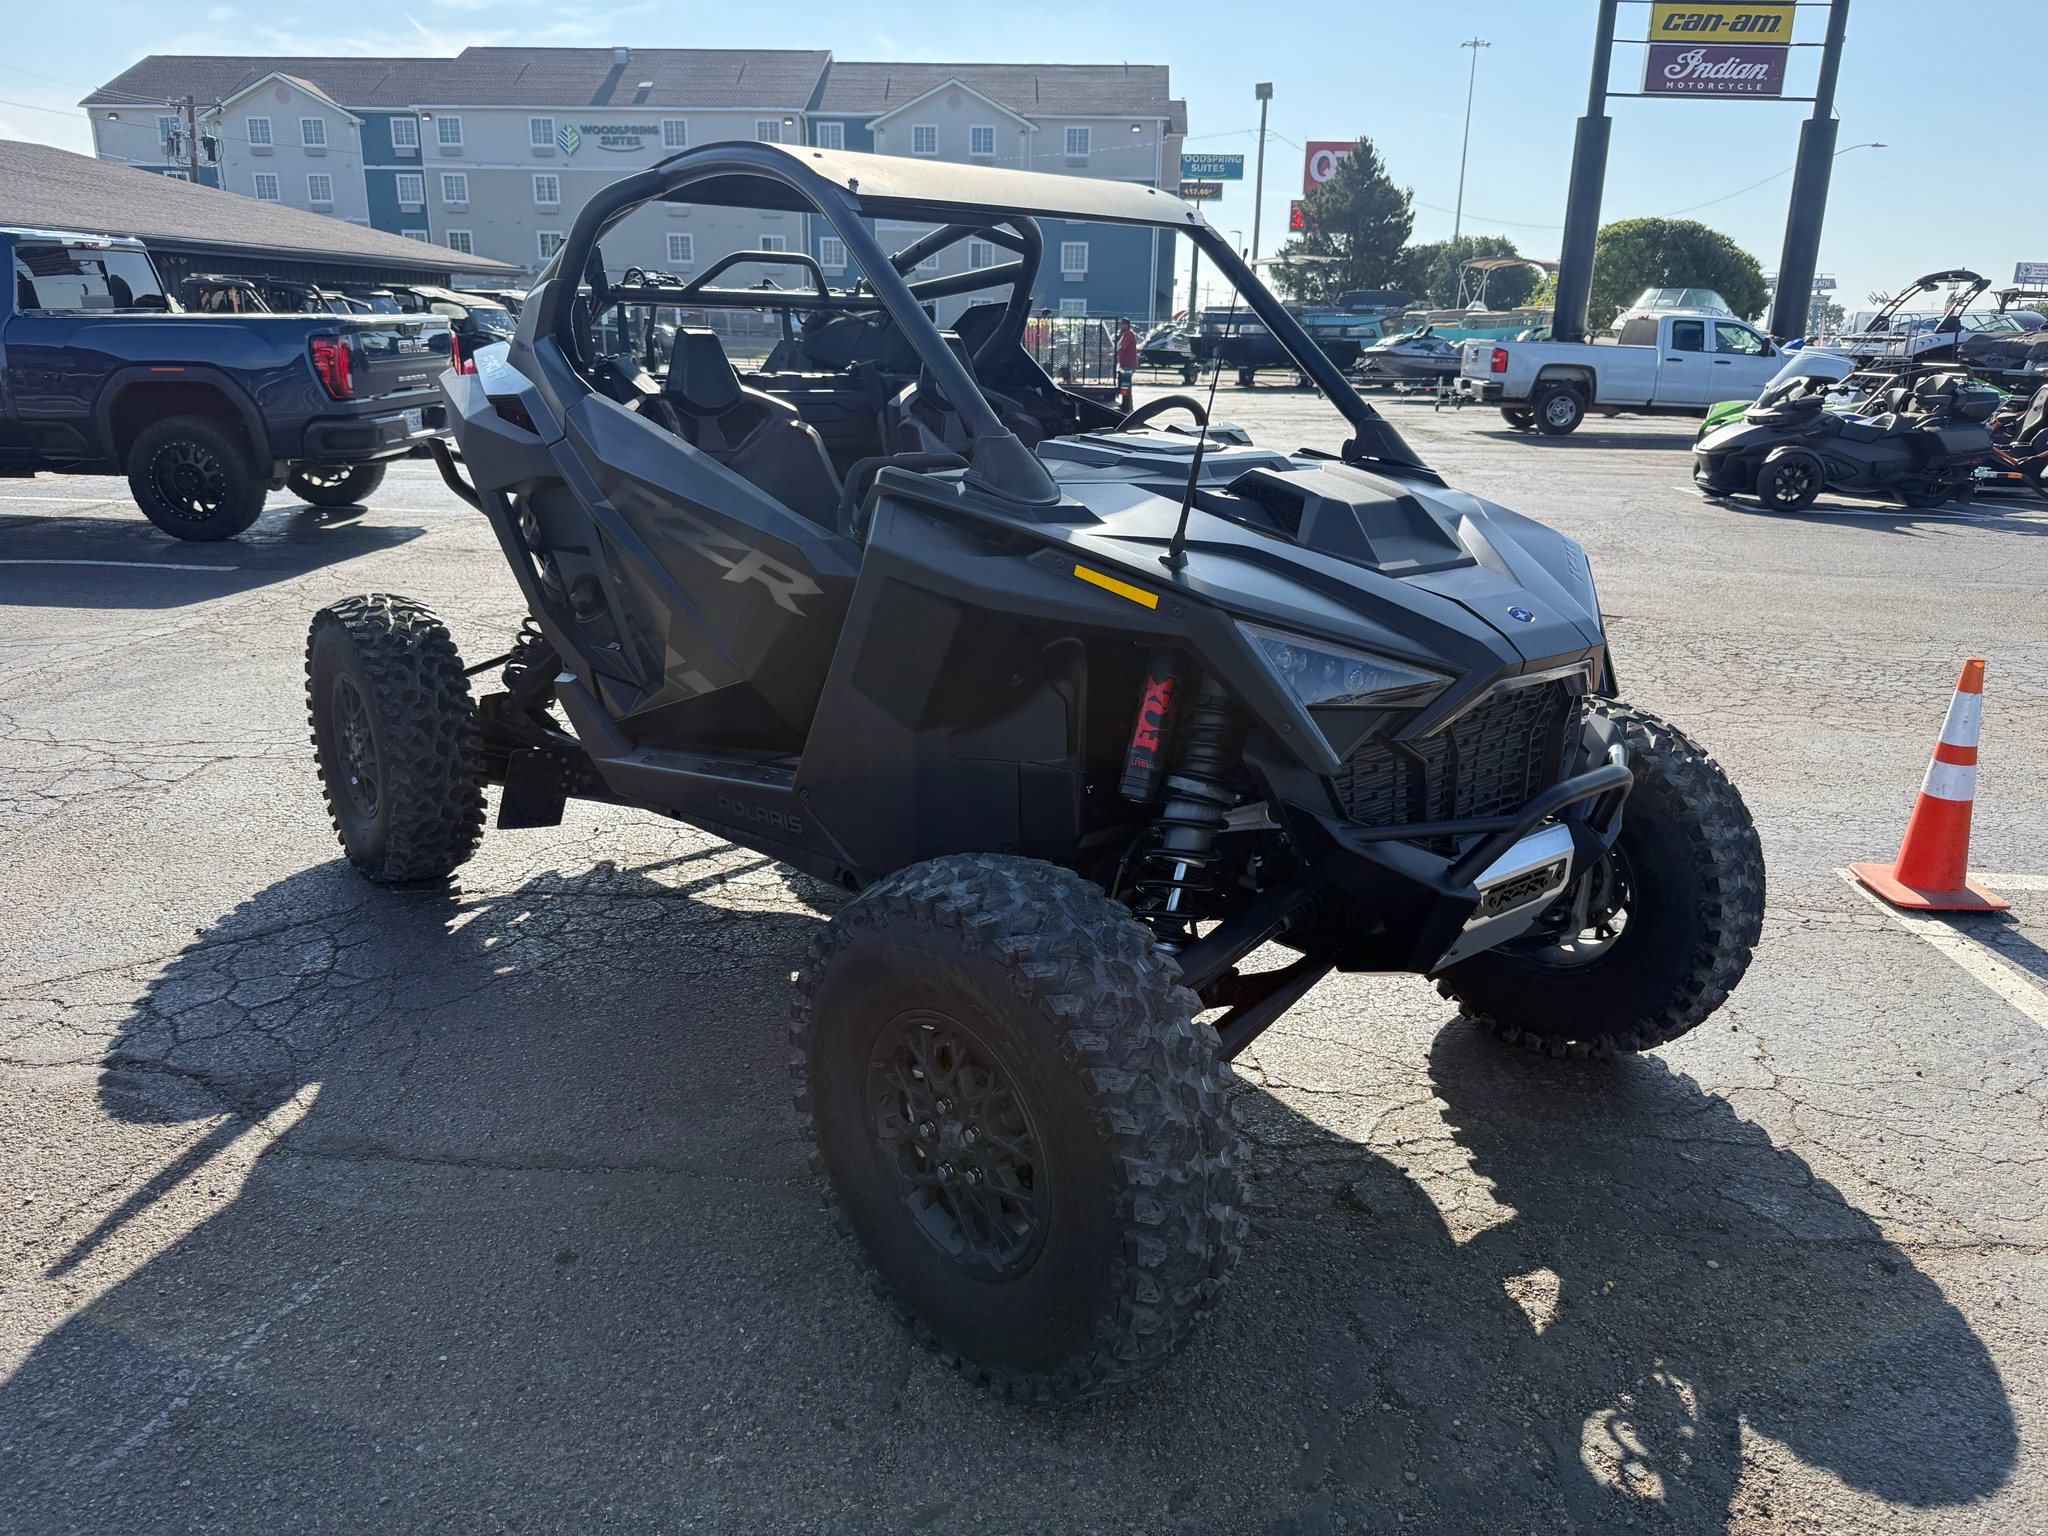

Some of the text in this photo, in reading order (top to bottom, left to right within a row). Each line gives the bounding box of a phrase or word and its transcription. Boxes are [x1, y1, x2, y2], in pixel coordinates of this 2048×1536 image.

[1662, 13, 1782, 33] can-am
[1663, 49, 1769, 80] Indian
[1666, 81, 1762, 91] MOTORCYCLE
[580, 124, 659, 135] WOODSPRING
[600, 136, 641, 146] SUITES
[1182, 155, 1242, 164] OODSPRING
[1191, 163, 1225, 172] SUITES
[1813, 279, 1831, 288] EATH
[398, 339, 429, 353] GMC
[1132, 675, 1177, 752] FOX
[718, 796, 804, 834] POLARIS
